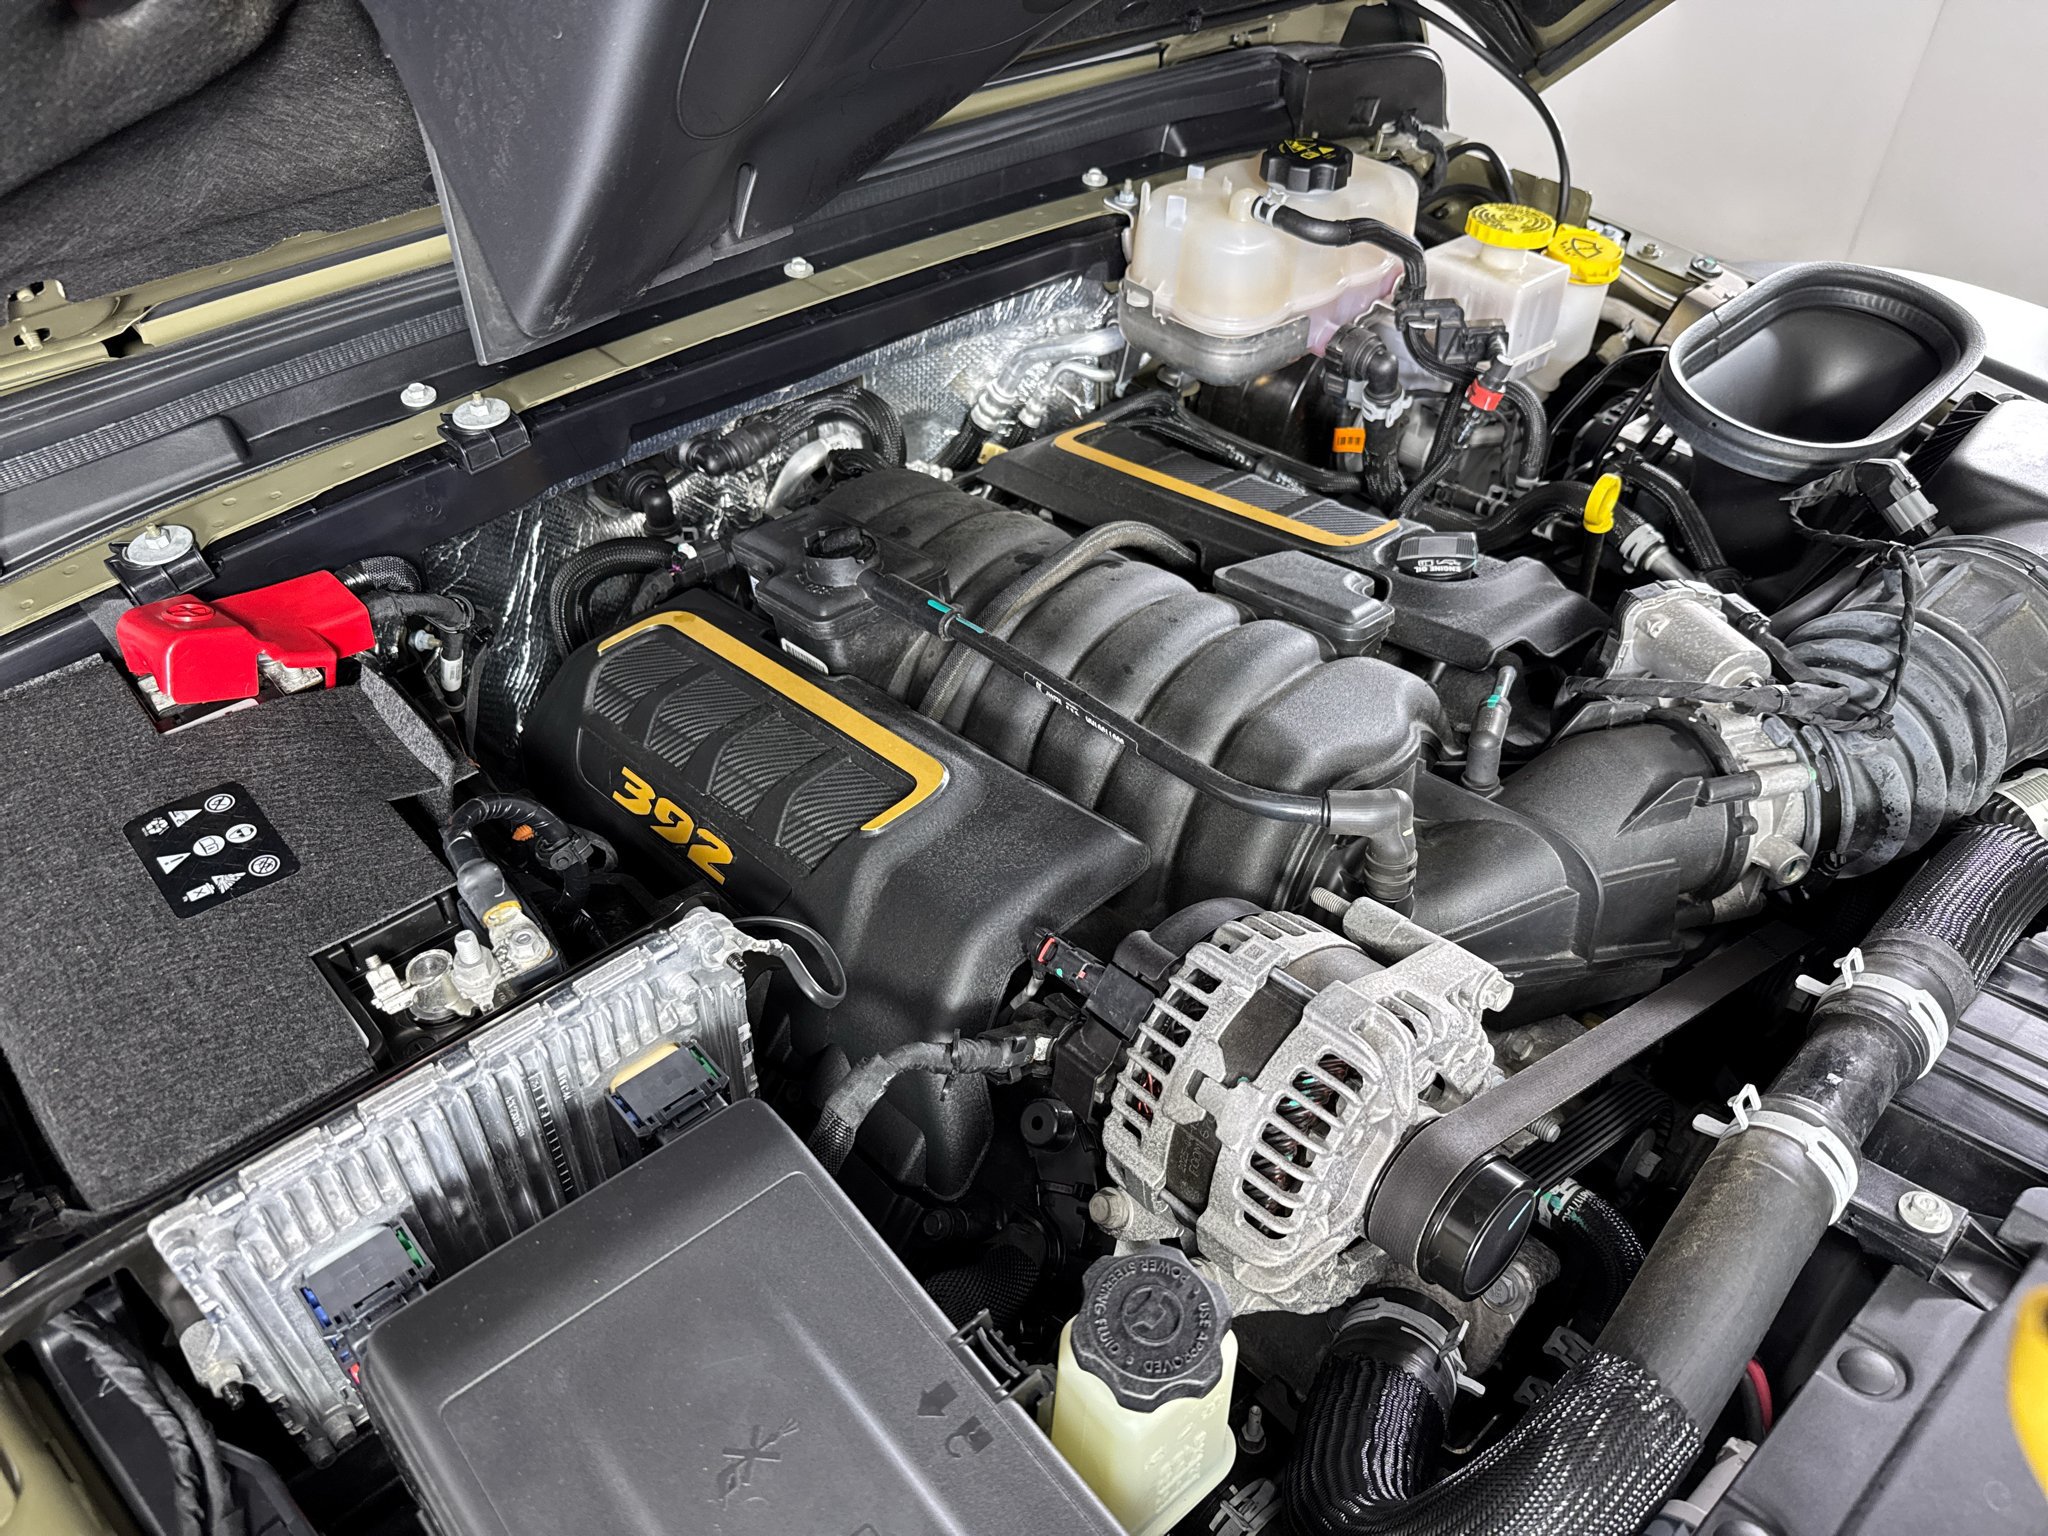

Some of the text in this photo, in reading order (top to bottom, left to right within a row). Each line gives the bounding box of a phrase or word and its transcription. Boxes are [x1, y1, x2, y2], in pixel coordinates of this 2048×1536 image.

[1413, 565, 1428, 573] OIL
[611, 767, 734, 885] 392
[1094, 1261, 1191, 1355] POWER STEERING FLUID
[1198, 1302, 1212, 1328] USE
[1143, 1331, 1209, 1374] APPROVED
